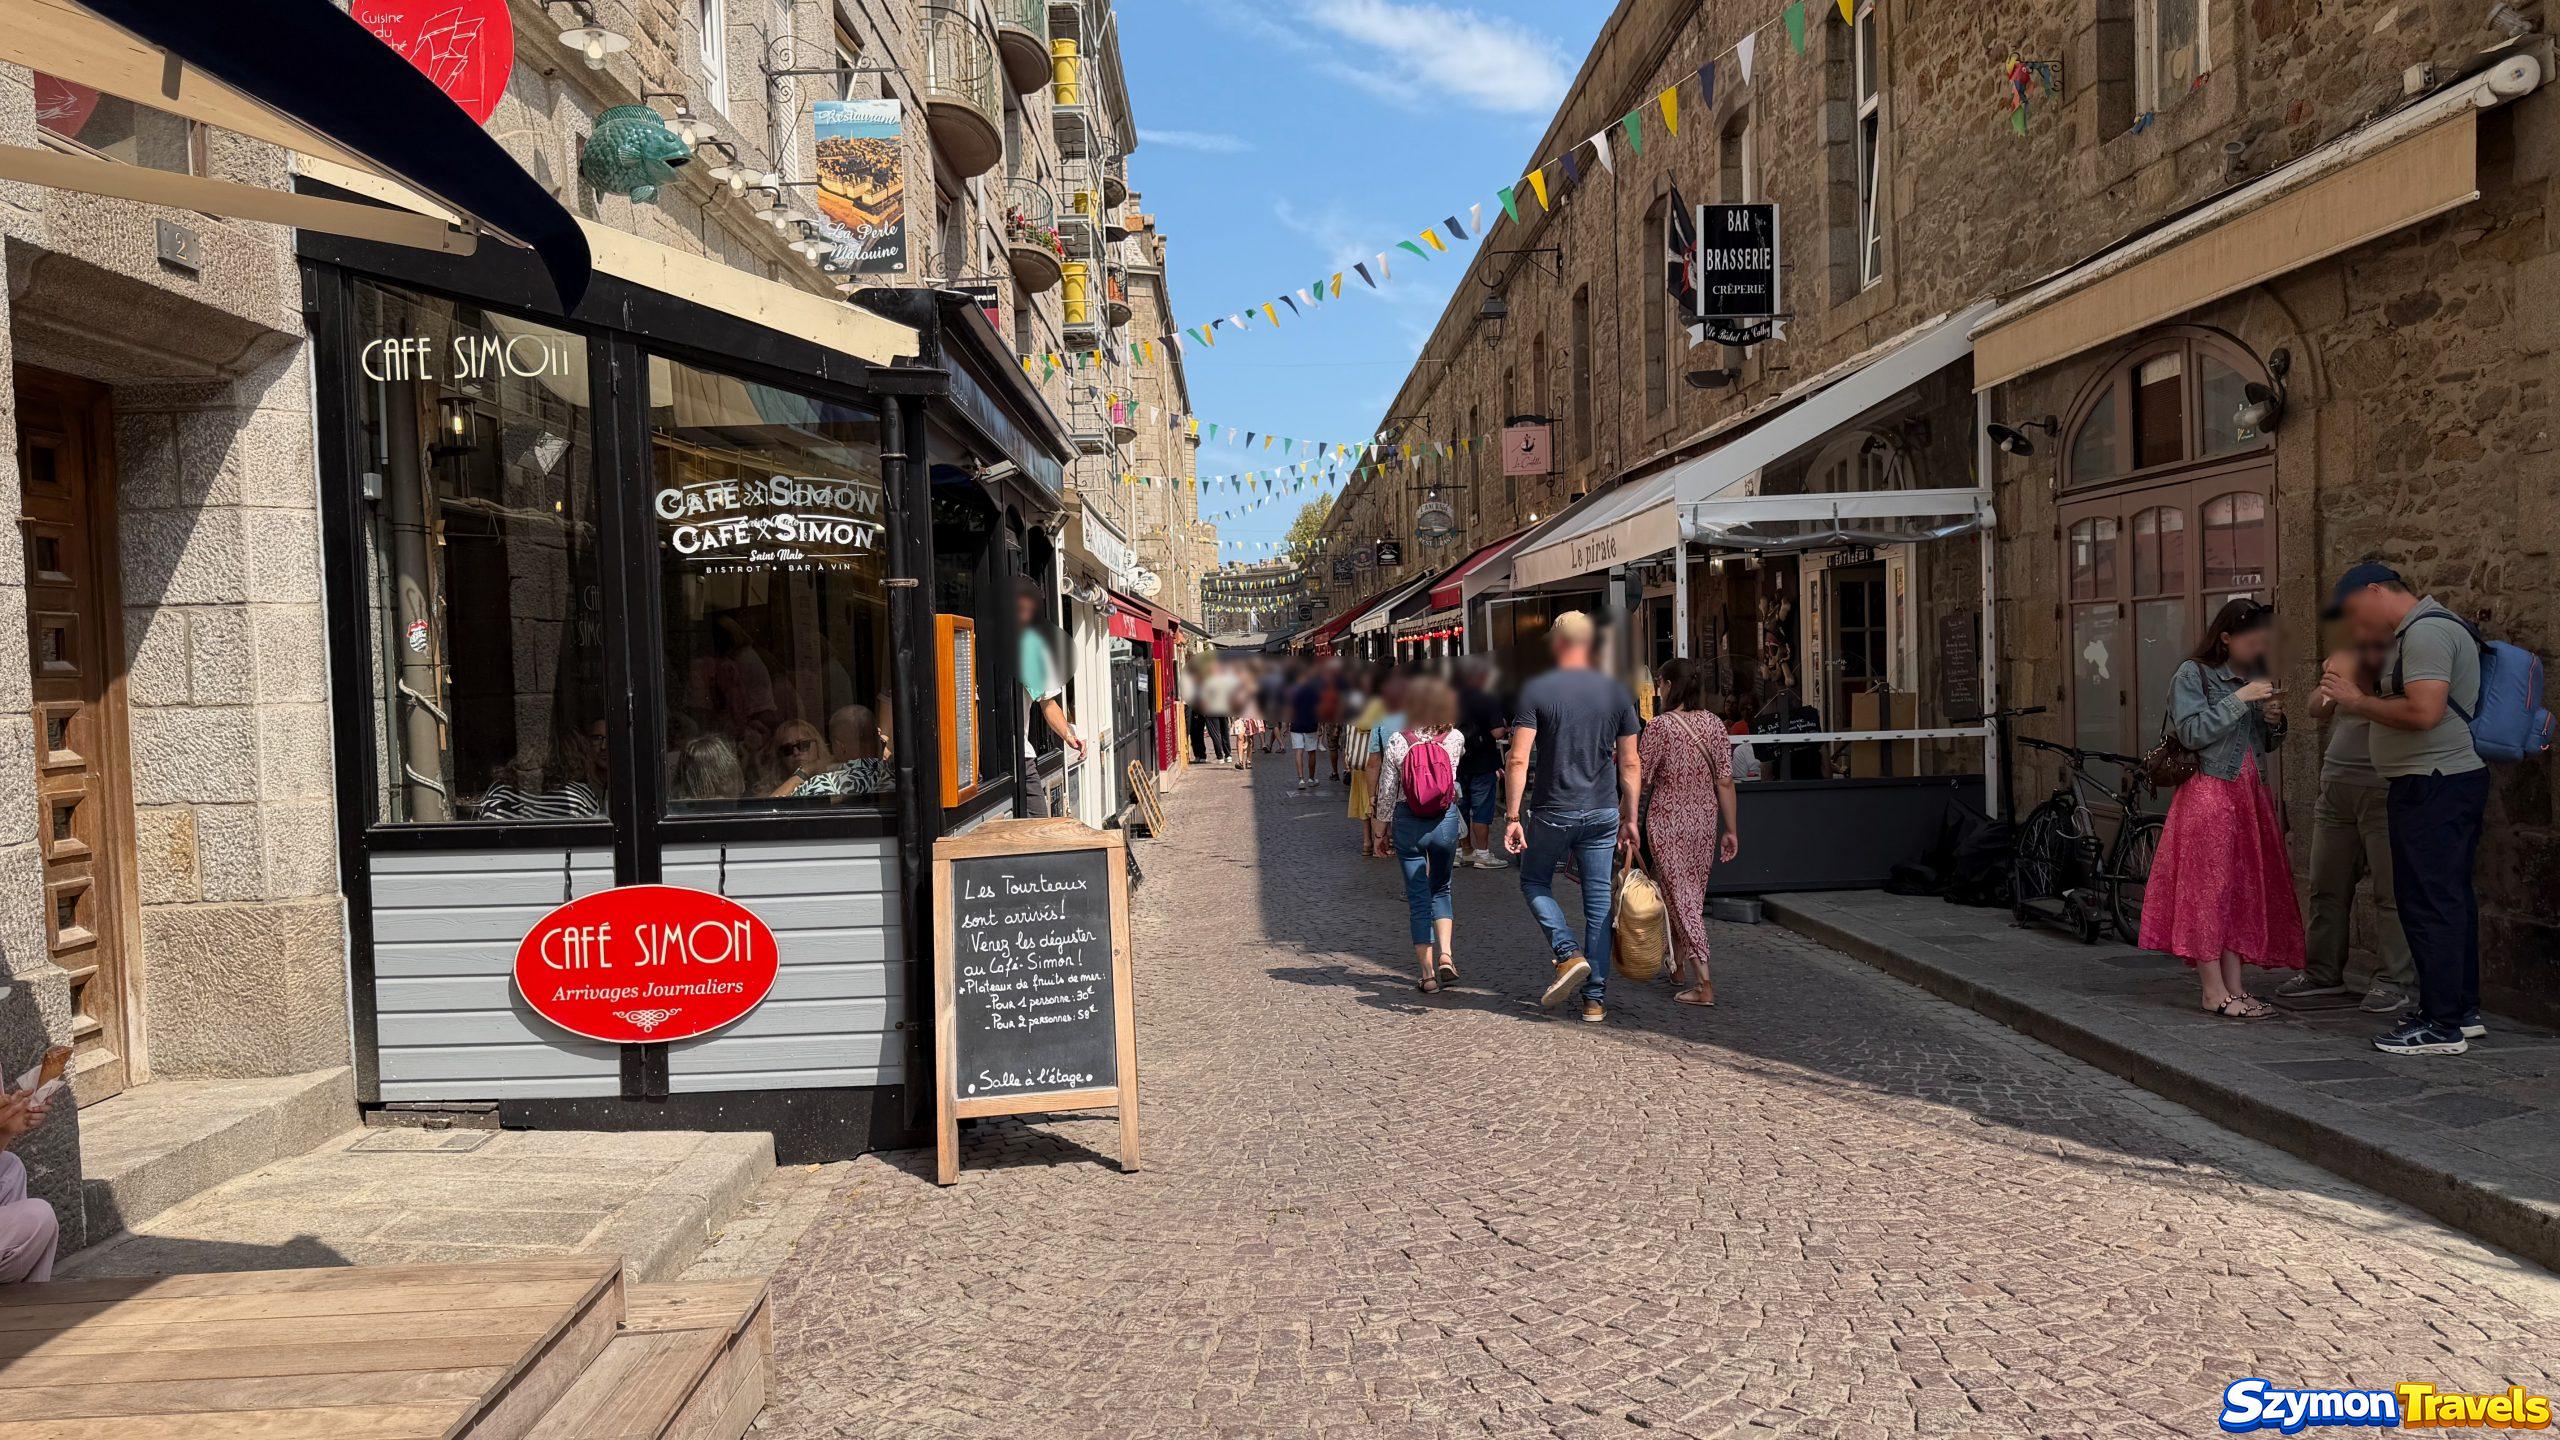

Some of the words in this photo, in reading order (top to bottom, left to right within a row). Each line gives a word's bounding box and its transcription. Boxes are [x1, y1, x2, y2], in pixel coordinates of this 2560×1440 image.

[361, 10, 405, 24] Cuisine
[373, 23, 393, 38] du
[818, 108, 898, 125] Restaurant
[827, 222, 854, 240] La
[856, 219, 899, 241] Perle
[1727, 209, 1750, 232] BAR
[175, 232, 188, 261] 2
[829, 242, 899, 261] Malouine
[1706, 247, 1771, 271] BRASSERIE
[1712, 283, 1766, 295] CRÊPERIE
[453, 333, 569, 379] SIMON
[775, 513, 875, 550] SIMON
[749, 549, 775, 562] Saint
[776, 548, 804, 561] Malo
[1570, 542, 1583, 569] Le
[1585, 533, 1617, 572] pirate
[706, 565, 762, 574] BISTROT
[788, 563, 811, 572] BAR
[817, 562, 825, 571] À
[831, 563, 850, 571] VIN
[964, 879, 996, 900] Les
[1001, 873, 1087, 895] Tourteaux
[961, 908, 998, 929] sont
[540, 921, 613, 970] CAFÉ
[634, 919, 752, 967] SIMON
[971, 931, 1010, 958] Venez
[1015, 931, 1036, 950] les
[1039, 927, 1097, 955] déguster
[963, 965, 987, 977] au
[551, 985, 639, 1003] Arrivages
[642, 978, 744, 998] Journaliers
[1015, 979, 1029, 990] de
[1032, 973, 1065, 992] fruits
[1067, 972, 1079, 983] de
[1017, 996, 1028, 1008] 1
[1017, 1014, 1028, 1028] 2
[1025, 1068, 1035, 1086] à
